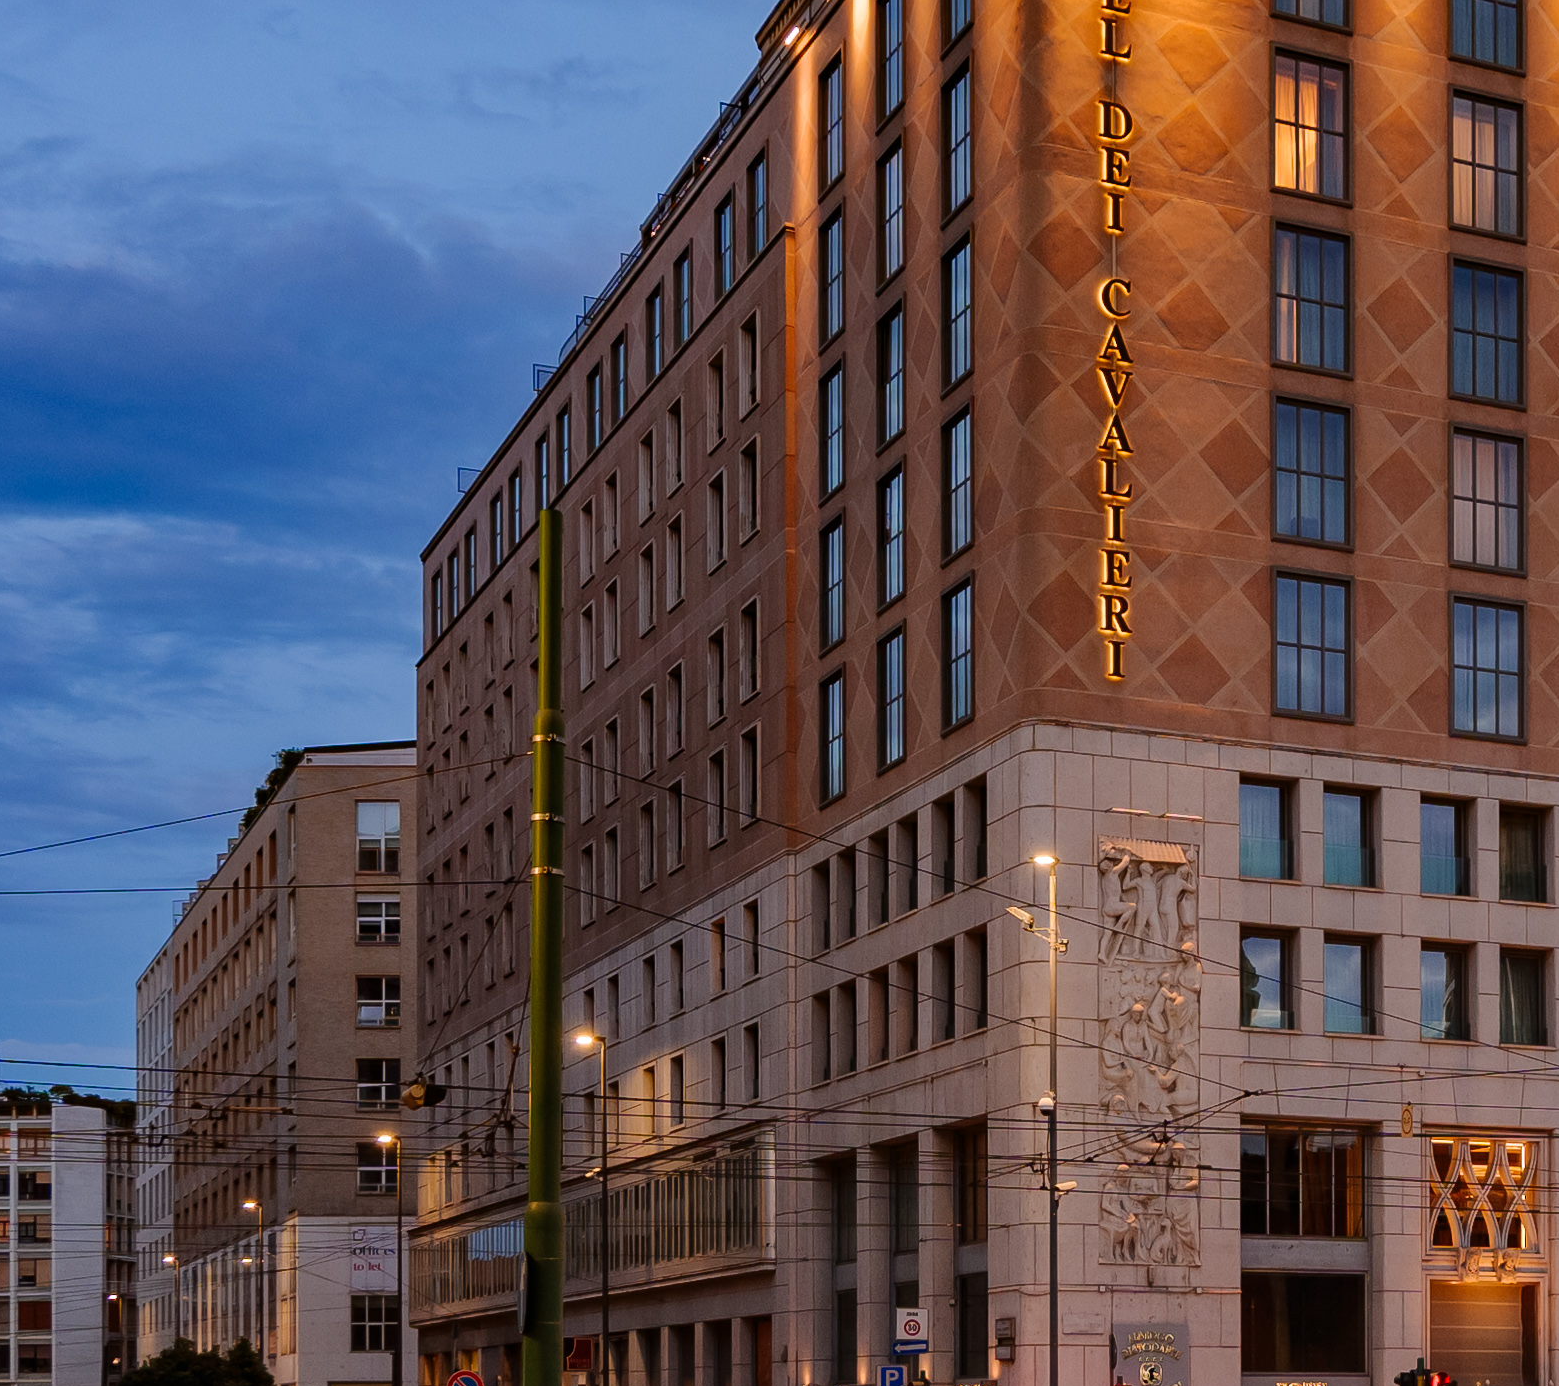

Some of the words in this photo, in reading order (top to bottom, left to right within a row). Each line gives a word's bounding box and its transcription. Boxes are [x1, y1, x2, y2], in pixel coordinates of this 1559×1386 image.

[1098, 98, 1134, 234] DEI
[1098, 278, 1135, 681] CAVALIERI
[885, 1369, 900, 1386] P
